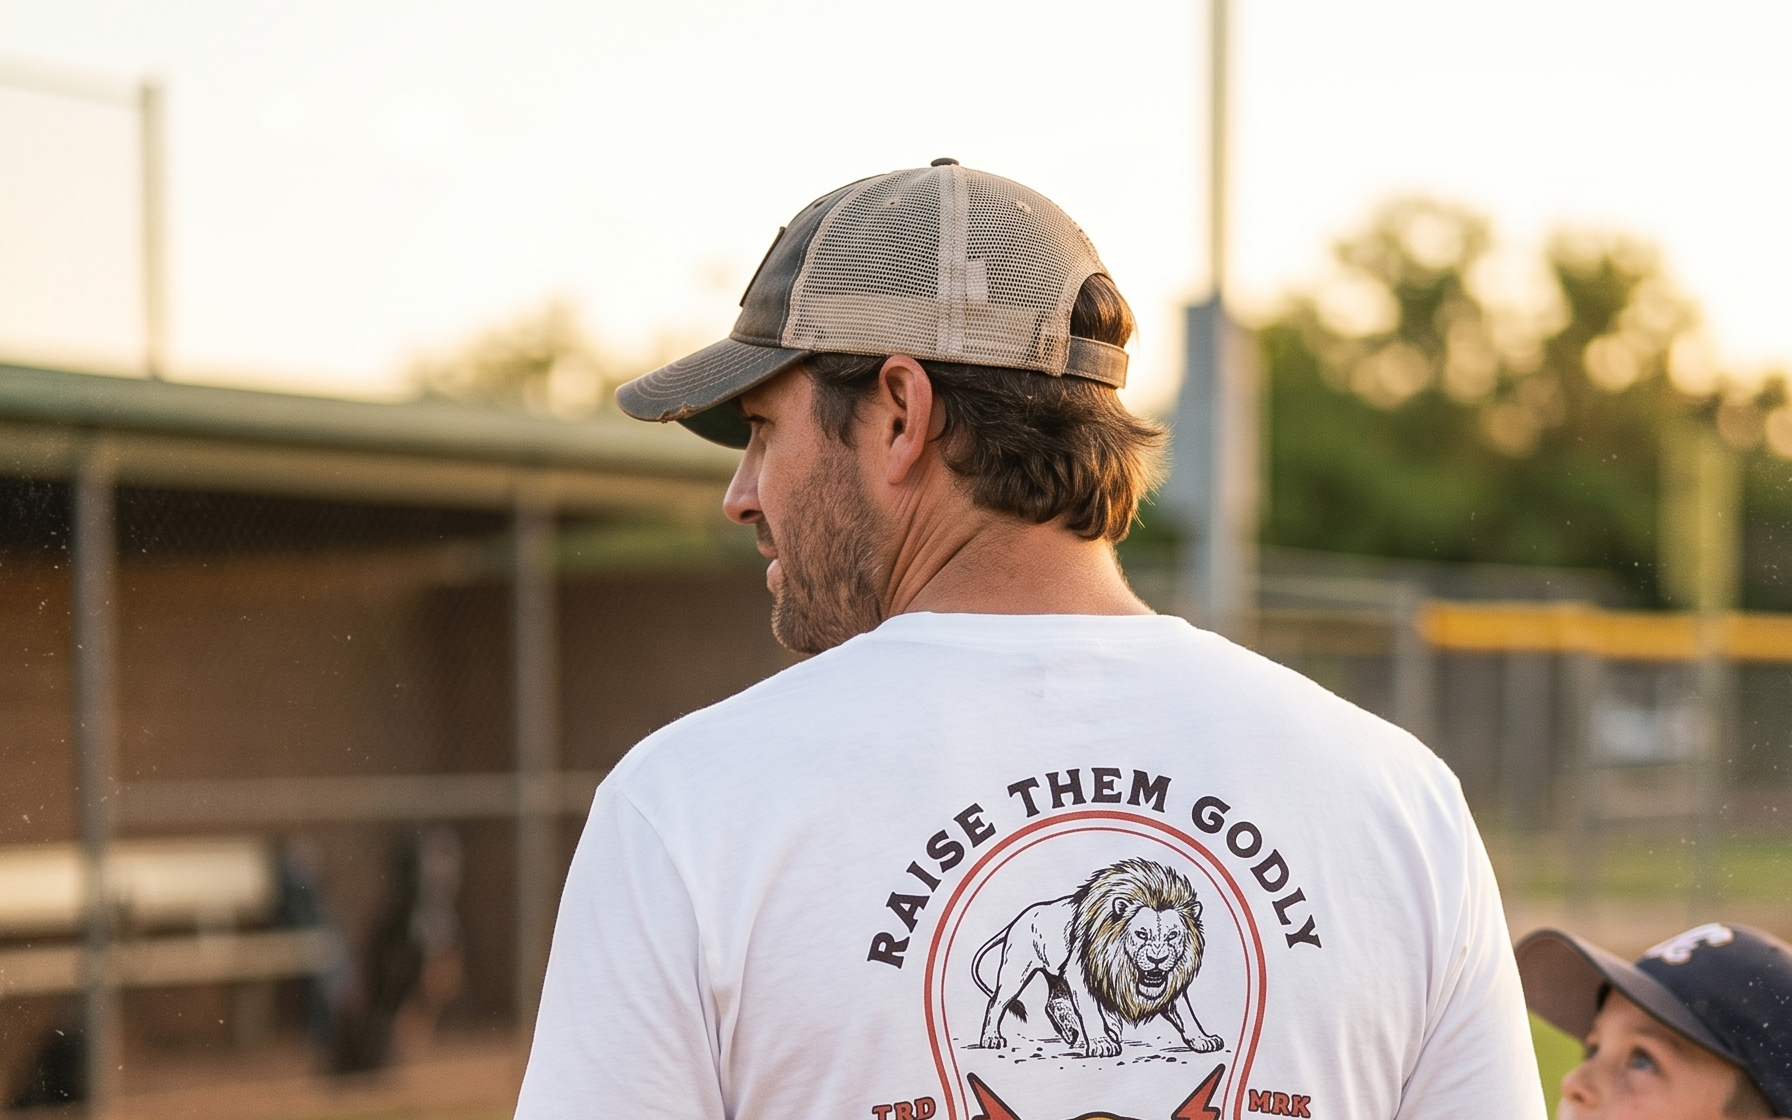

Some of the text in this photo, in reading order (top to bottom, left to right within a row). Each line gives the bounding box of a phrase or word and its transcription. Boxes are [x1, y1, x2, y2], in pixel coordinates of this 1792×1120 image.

[867, 767, 1322, 970] RAISE THEM GODLY
[1247, 1088, 1312, 1119] MRK
